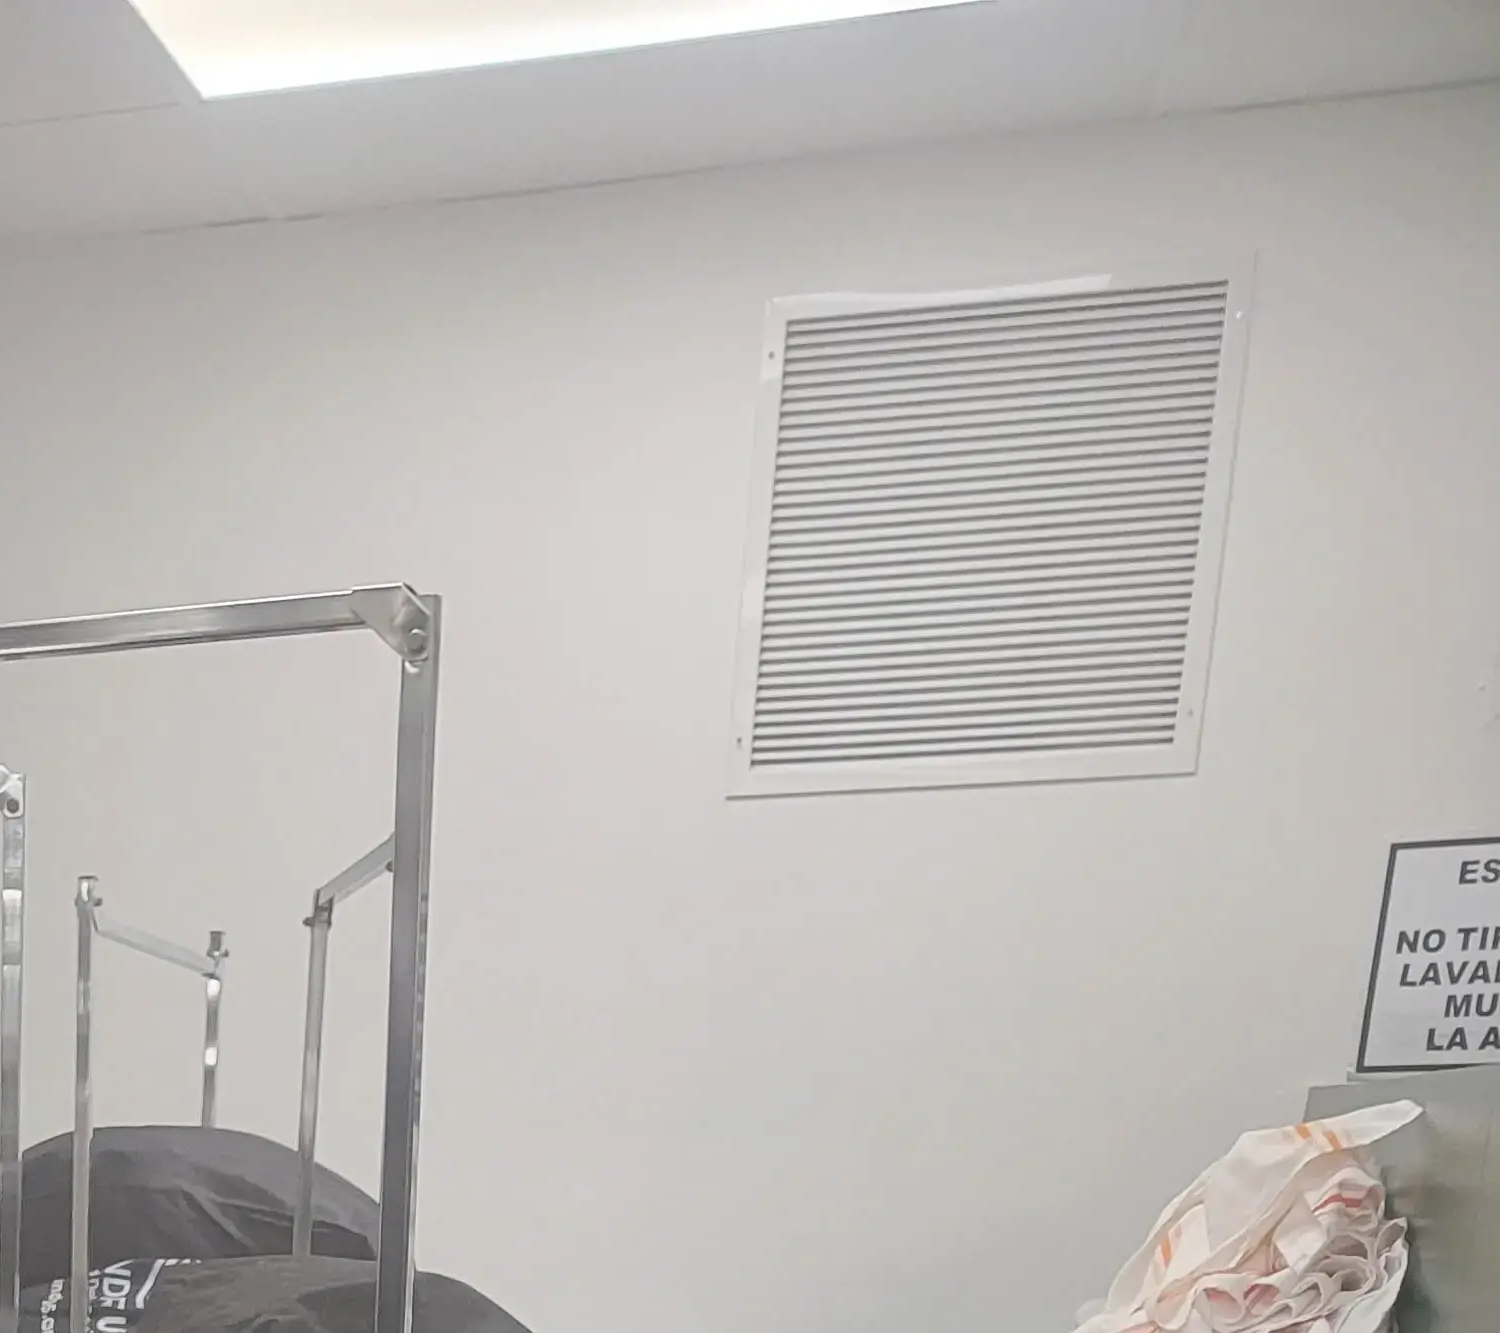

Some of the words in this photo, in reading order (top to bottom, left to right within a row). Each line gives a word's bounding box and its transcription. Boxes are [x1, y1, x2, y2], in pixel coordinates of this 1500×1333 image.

[1396, 928, 1446, 954] NO
[1400, 960, 1500, 987] LAVA
[1426, 1026, 1468, 1051] LA
